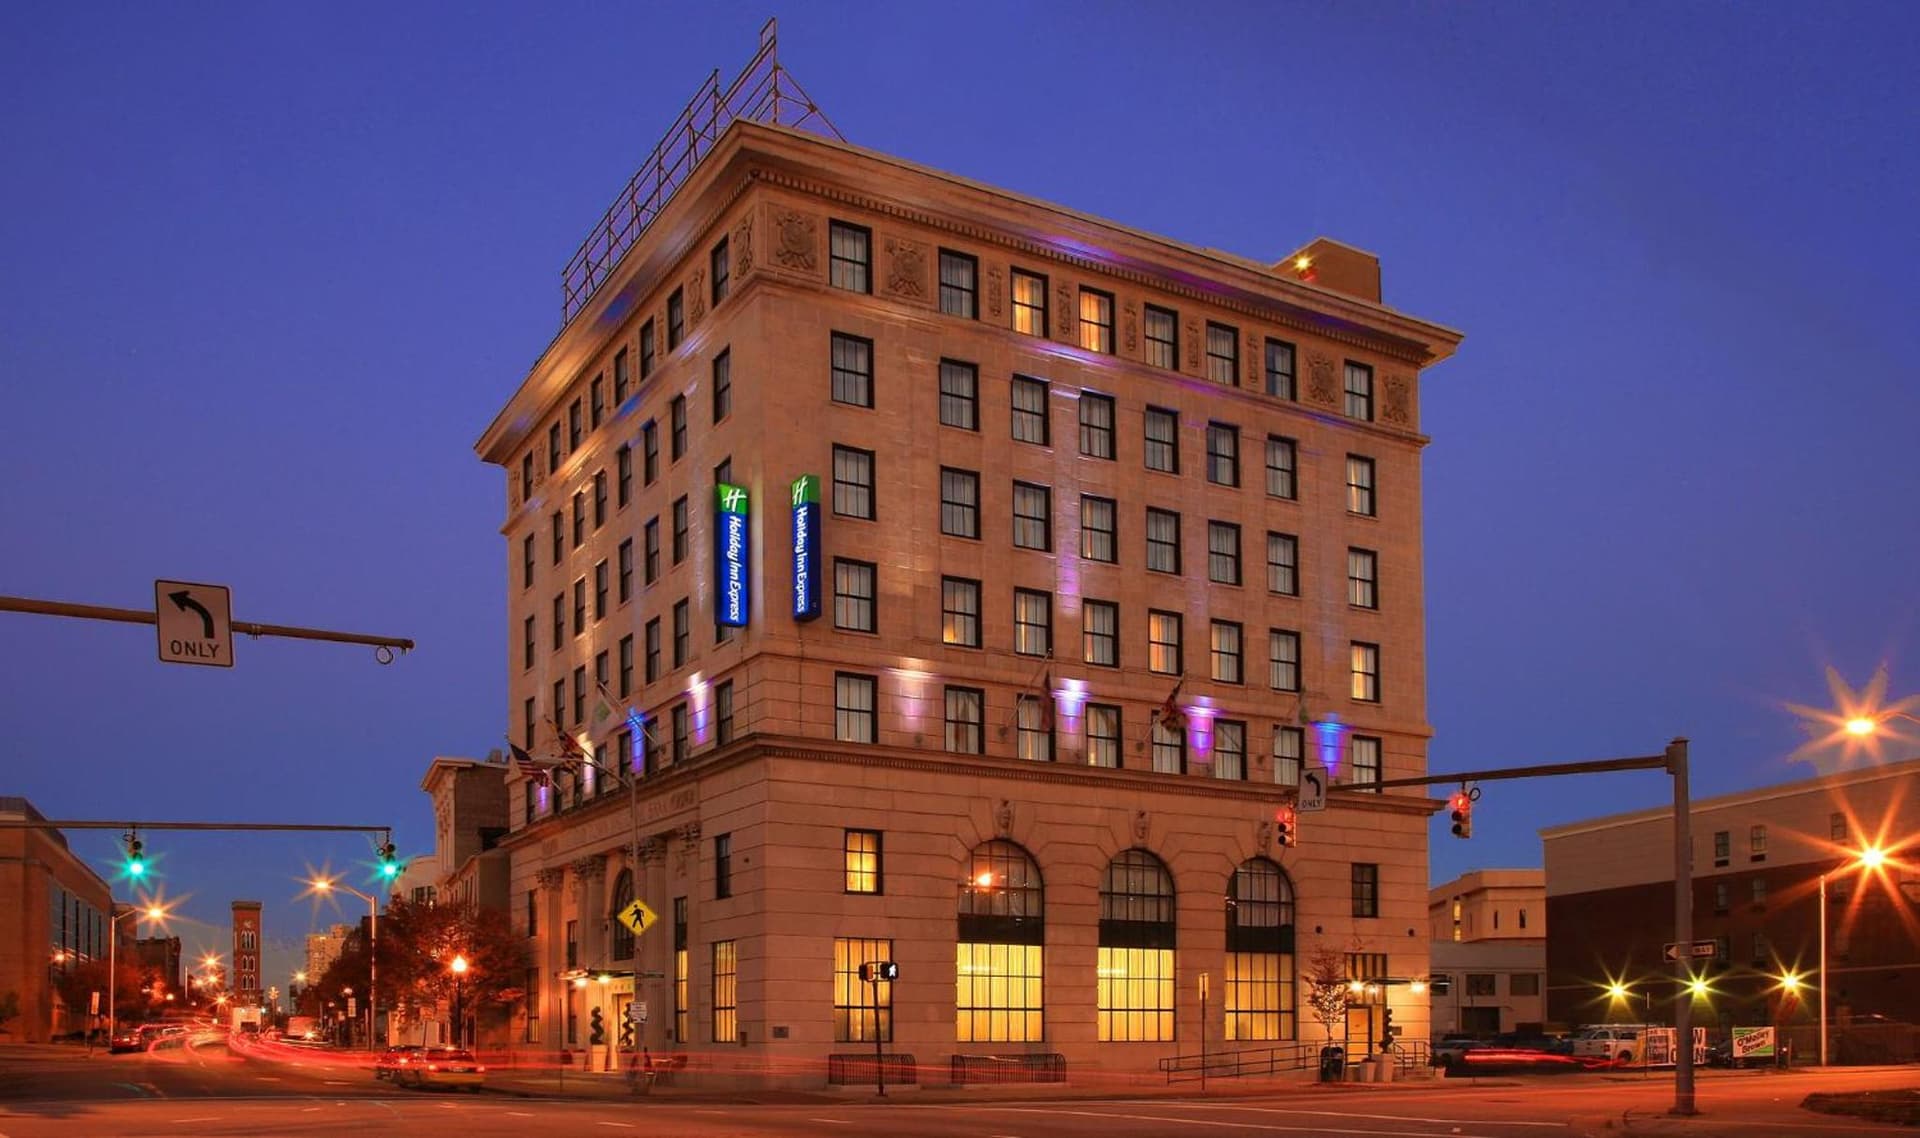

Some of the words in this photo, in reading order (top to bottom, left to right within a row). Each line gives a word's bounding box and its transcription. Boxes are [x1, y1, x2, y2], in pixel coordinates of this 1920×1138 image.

[727, 515, 742, 561] Holiday
[795, 506, 808, 553] Holiday
[728, 559, 743, 582] Inn
[797, 553, 808, 573] Inn
[728, 581, 742, 622] Express
[795, 573, 808, 613] Express
[170, 639, 220, 659] ONLY
[1302, 799, 1321, 808] ONLY
